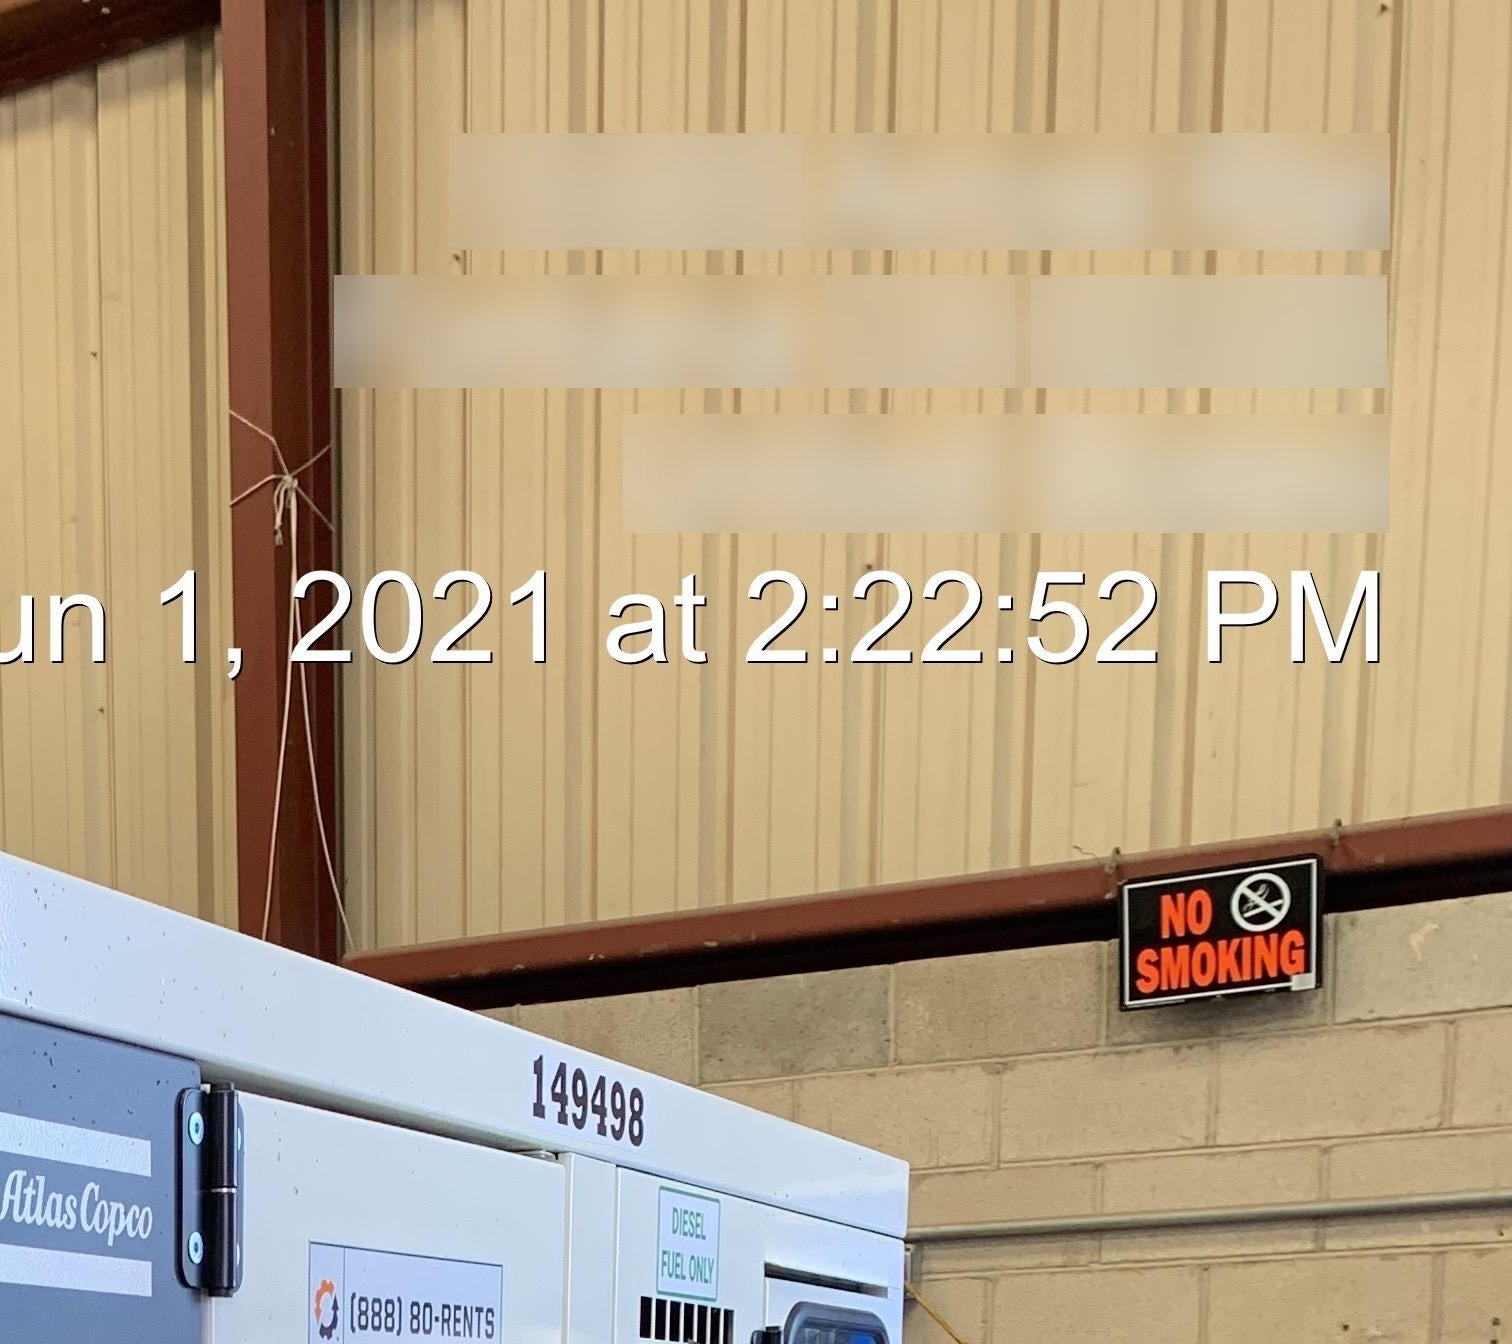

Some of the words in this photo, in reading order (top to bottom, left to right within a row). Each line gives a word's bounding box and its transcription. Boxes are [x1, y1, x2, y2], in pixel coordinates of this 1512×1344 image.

[1160, 888, 1213, 939] NO
[1135, 929, 1306, 994] SMOKING
[532, 1054, 645, 1147] 149498
[80, 1181, 153, 1247] Copco
[671, 1206, 707, 1241] DIESEL
[660, 1250, 687, 1281] FUEL
[689, 1255, 716, 1285] ONLY
[350, 1292, 403, 1337] (888)
[409, 1301, 495, 1340] 80-RENTS
